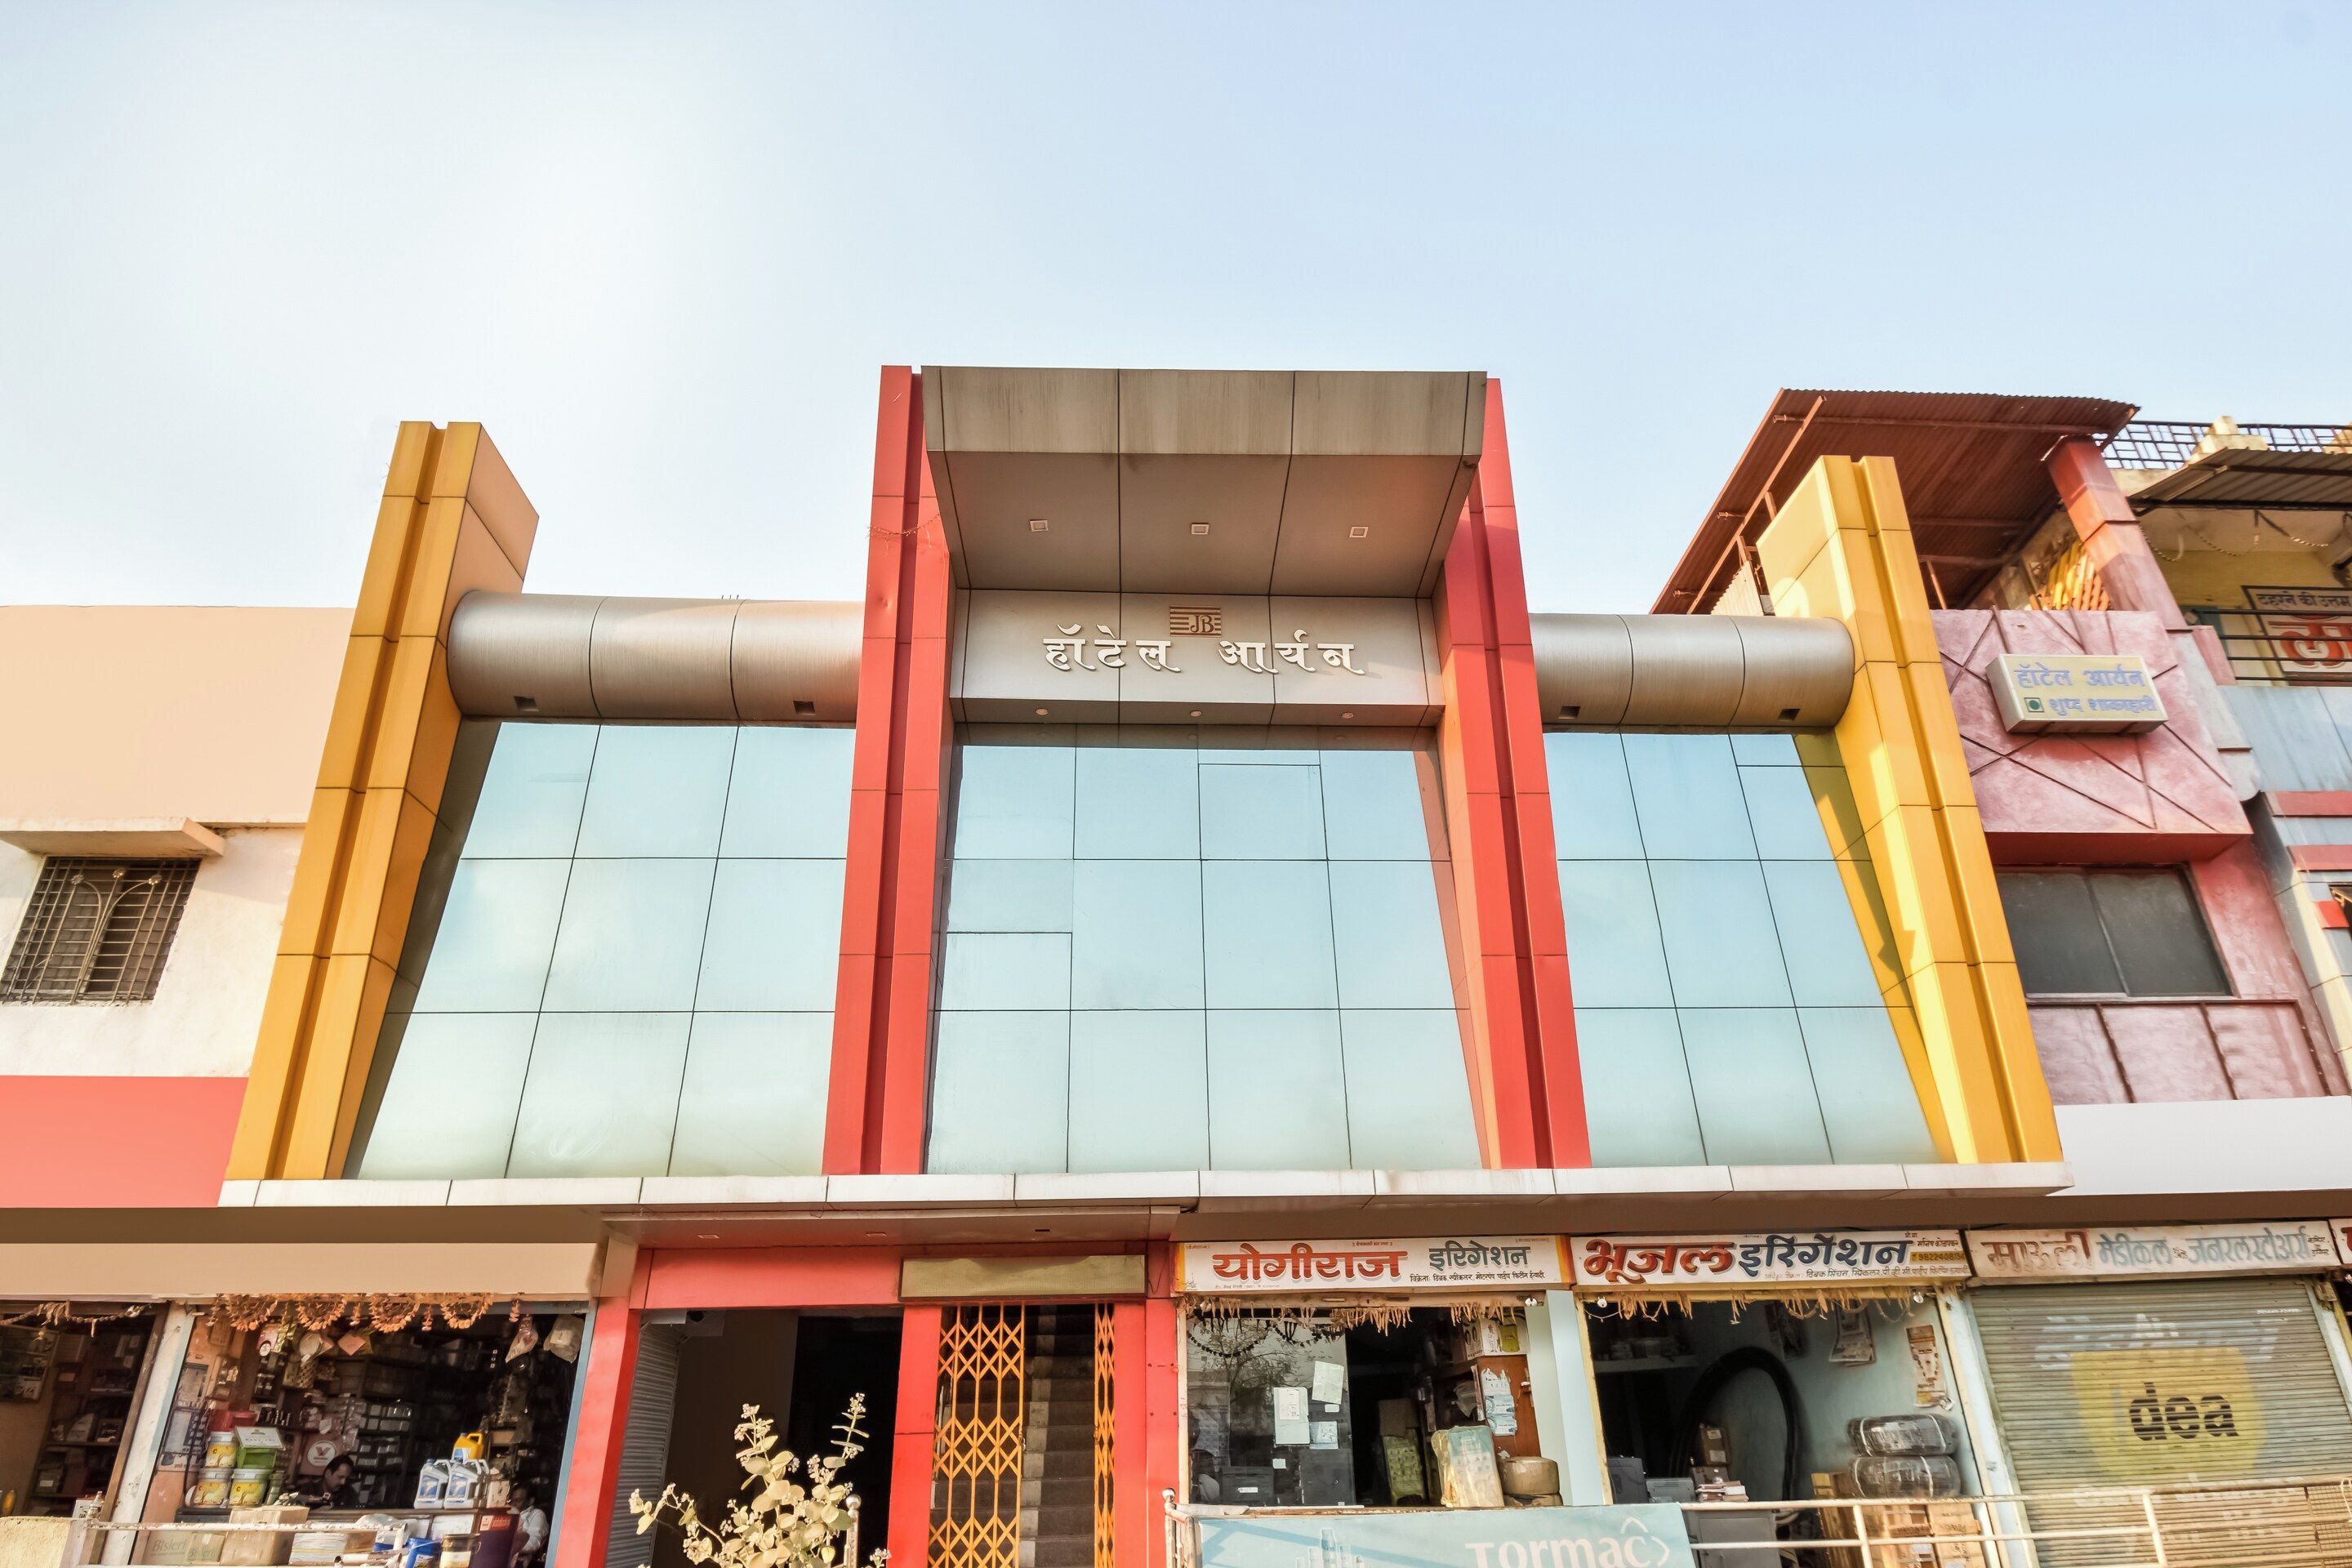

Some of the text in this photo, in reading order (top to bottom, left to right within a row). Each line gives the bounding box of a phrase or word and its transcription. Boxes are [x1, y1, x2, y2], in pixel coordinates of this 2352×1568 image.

[1190, 614, 1215, 634] JB
[1043, 623, 1365, 675] हॉटेल आर्यन
[2014, 662, 2146, 688] हॉटेल आर्यन
[1213, 1241, 1531, 1281] योगीराज इरिगेशन
[1584, 1238, 1735, 1284] भूजल
